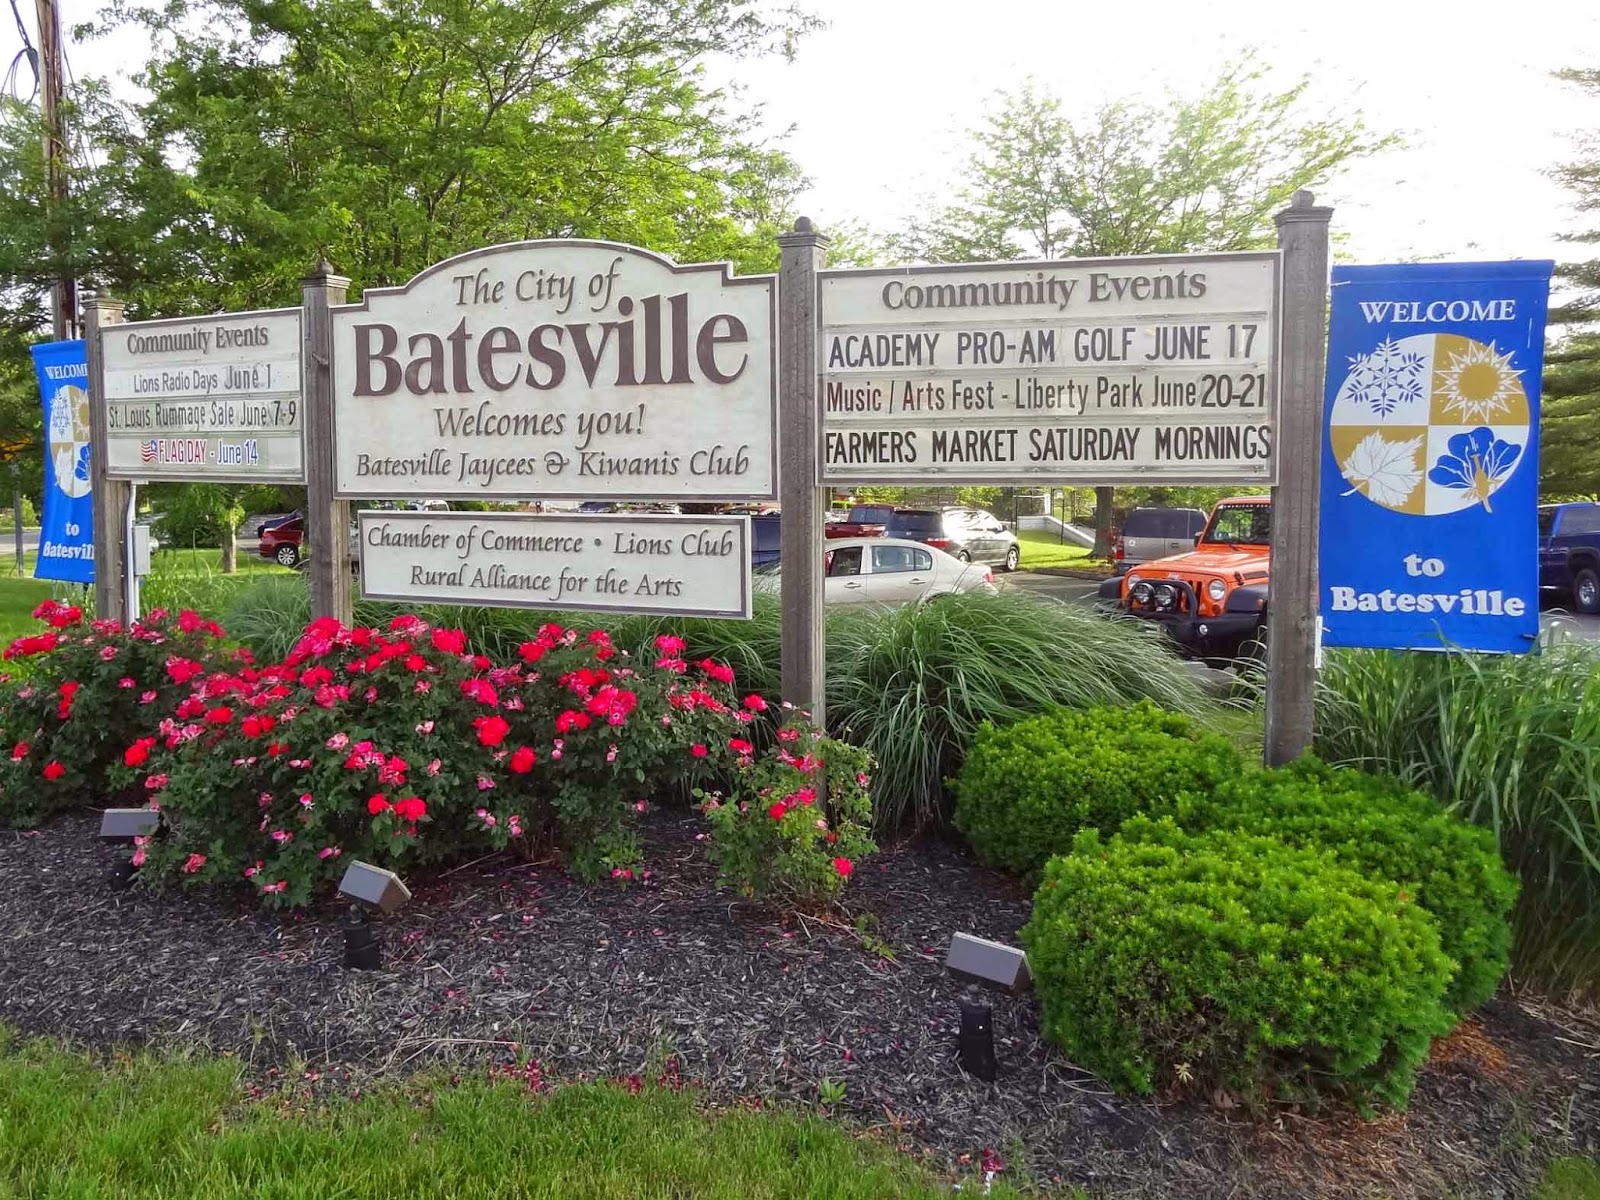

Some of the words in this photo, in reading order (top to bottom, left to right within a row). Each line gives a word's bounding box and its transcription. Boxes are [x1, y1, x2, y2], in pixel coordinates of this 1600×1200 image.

[453, 267, 504, 306] The
[515, 269, 576, 314] City
[588, 256, 623, 312] of
[882, 272, 1079, 312] Community
[1088, 268, 1208, 302] Events
[1359, 299, 1516, 324] WELCOME
[127, 326, 214, 355] Community
[215, 324, 269, 349] Events
[352, 291, 750, 397] Batesville
[828, 333, 940, 368] ACADEMY
[957, 329, 1056, 365] PRO-AM
[1074, 327, 1137, 362] GOLF
[1145, 325, 1212, 361] JUNE
[1227, 323, 1258, 359] 17
[134, 373, 160, 393] Lions
[162, 372, 190, 391] Radio
[193, 369, 218, 394] Days
[224, 365, 259, 390] June
[266, 363, 272, 389] 1
[826, 382, 882, 413] Music
[902, 380, 945, 411] Arts
[952, 379, 995, 410] Fest
[1015, 377, 1089, 415] Liberty
[1097, 375, 1143, 409] Park
[1151, 374, 1197, 408] June
[1200, 373, 1266, 408] 20-21
[109, 405, 120, 429] St.
[124, 405, 151, 427] Louis
[155, 402, 206, 431] Rummage
[210, 401, 235, 426] Sale
[240, 401, 267, 426] June
[434, 400, 567, 438] Welcomes
[575, 403, 646, 450] you!
[158, 440, 185, 464] FLAG
[186, 439, 207, 463] DAY
[217, 440, 242, 464] June
[244, 440, 259, 464] 14
[825, 431, 918, 465] FARMERS
[932, 429, 1018, 463] MARKET
[1028, 427, 1141, 463] SATURDAY
[1154, 425, 1272, 460] MORNINGS
[356, 449, 452, 477] Batesville
[457, 451, 535, 487] Jaycees
[577, 450, 680, 477] Kiwanis
[689, 445, 750, 476] Club
[65, 521, 80, 536] to
[367, 525, 450, 550] Chamber
[455, 524, 477, 559] of
[480, 529, 583, 553] Commerce
[612, 532, 671, 555] Lions
[681, 528, 734, 557] Club
[42, 540, 95, 560] Batesvill
[1403, 552, 1445, 578] to
[410, 565, 464, 588] Rural
[470, 564, 551, 591] Alliance
[549, 566, 589, 601] for
[595, 568, 627, 594] the
[633, 572, 684, 597] Arts
[1330, 586, 1525, 617] Batesville
